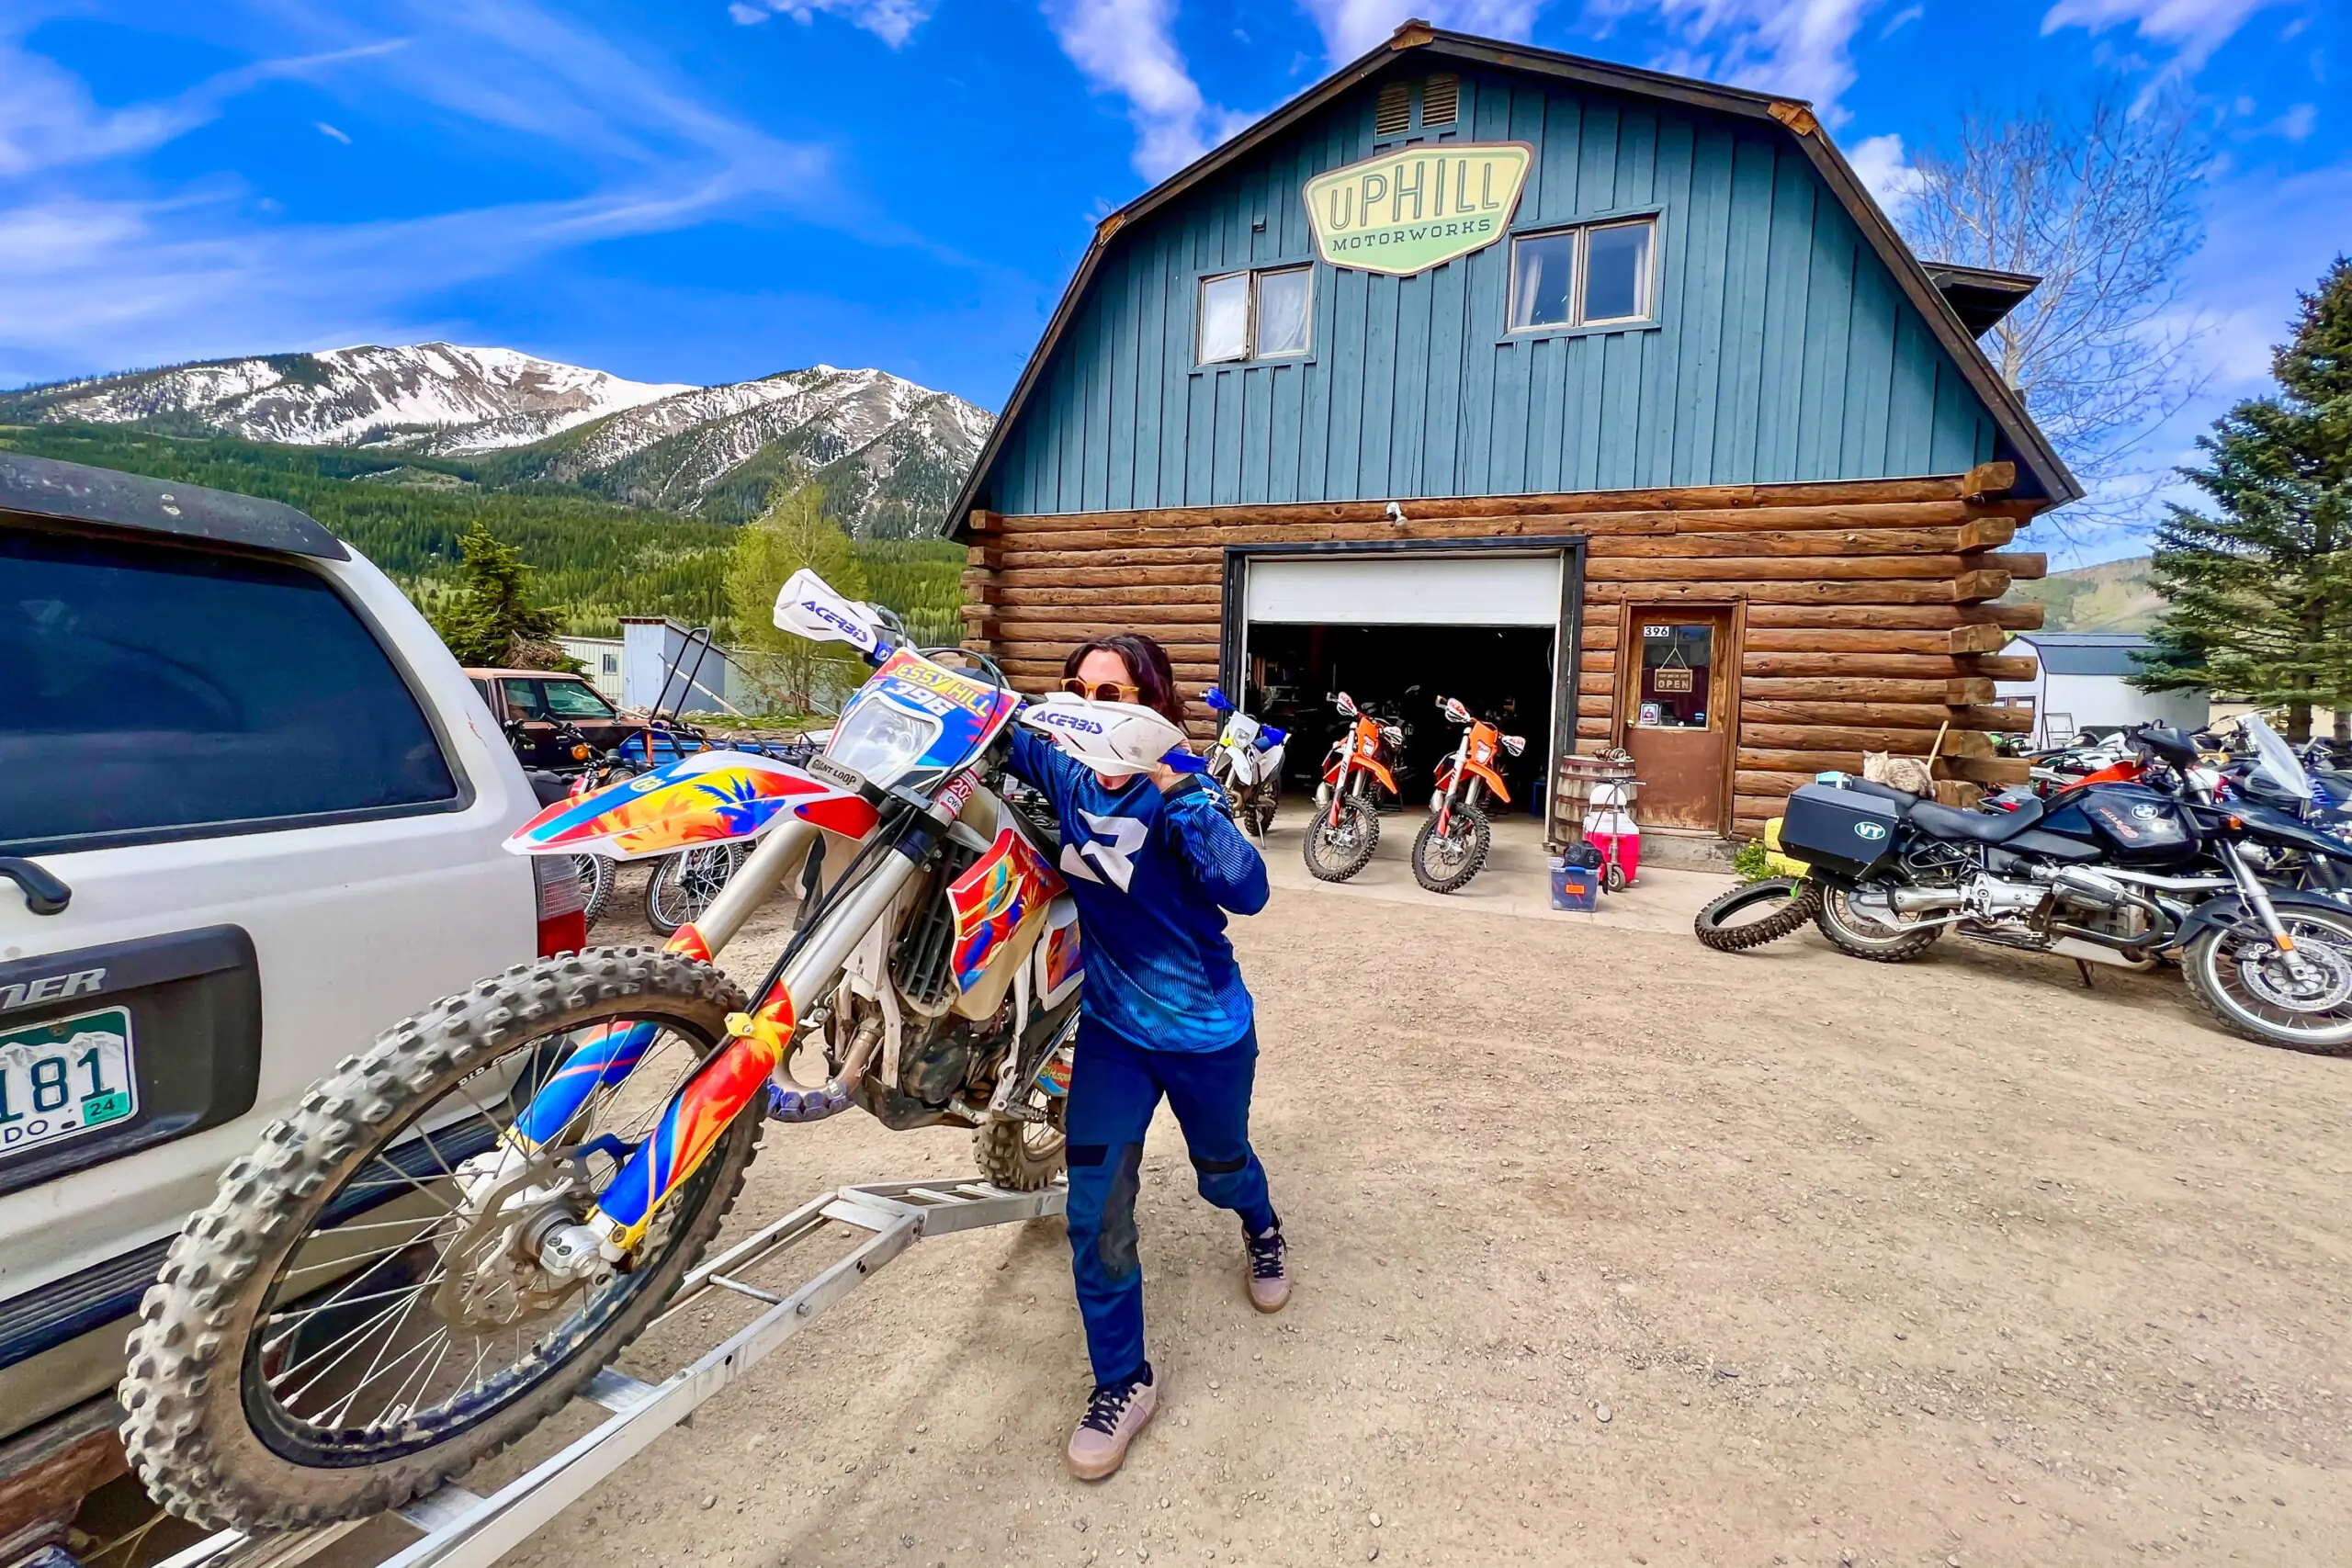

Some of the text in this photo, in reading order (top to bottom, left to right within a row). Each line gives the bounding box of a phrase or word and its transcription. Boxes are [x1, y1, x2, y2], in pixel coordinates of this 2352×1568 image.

[1329, 158, 1499, 231] UPHILL
[1332, 219, 1491, 252] MOTORWORKS
[1645, 626, 1668, 637] 396
[887, 663, 990, 718] JESSY HILL
[1657, 680, 1689, 689] OPEN
[883, 681, 957, 717] 396
[811, 759, 857, 785] GIANT LOOP
[1860, 823, 1883, 838] VT
[90, 1098, 116, 1117] 24
